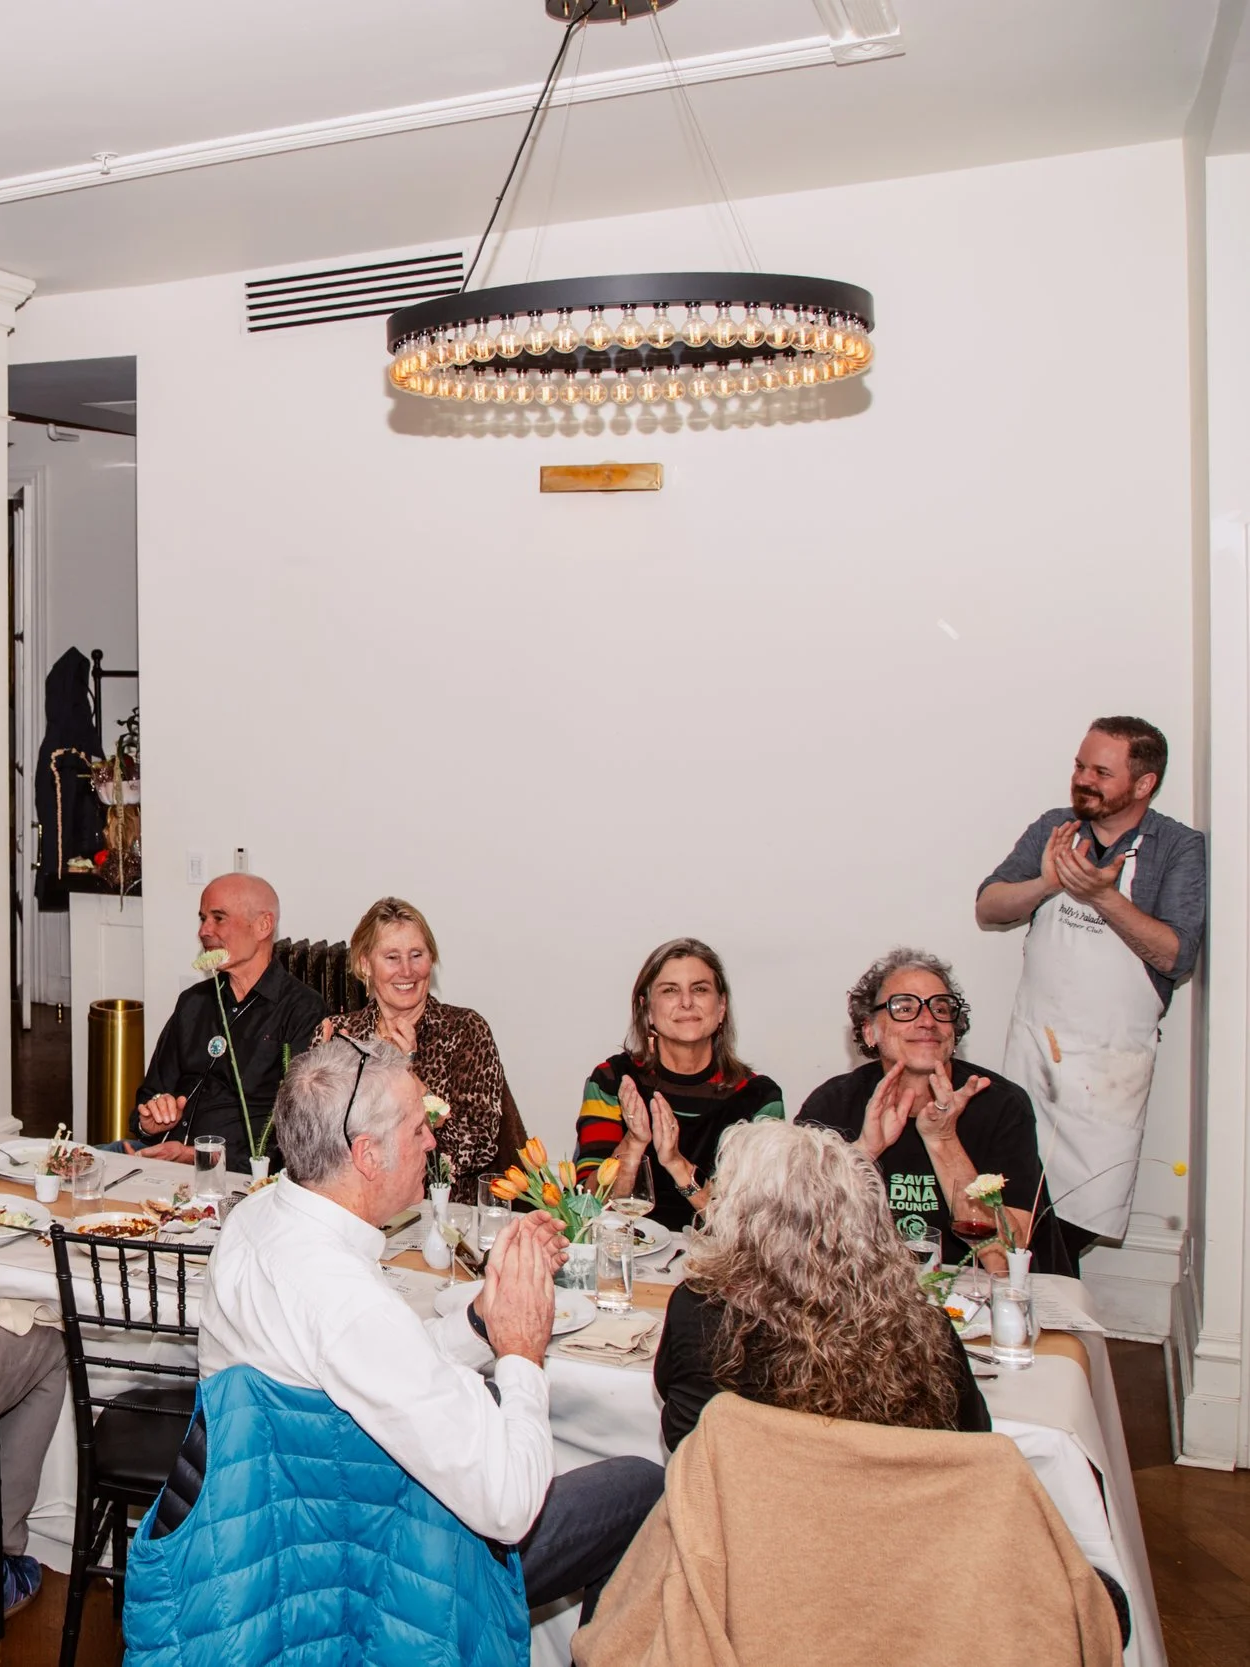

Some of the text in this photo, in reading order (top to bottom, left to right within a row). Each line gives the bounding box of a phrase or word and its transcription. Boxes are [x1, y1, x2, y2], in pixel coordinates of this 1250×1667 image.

[1063, 918, 1085, 929] Supper
[1086, 925, 1104, 935] Club
[890, 1173, 936, 1186] SAVE
[890, 1183, 938, 1202] DNA
[889, 1200, 939, 1212] LOUNGE
